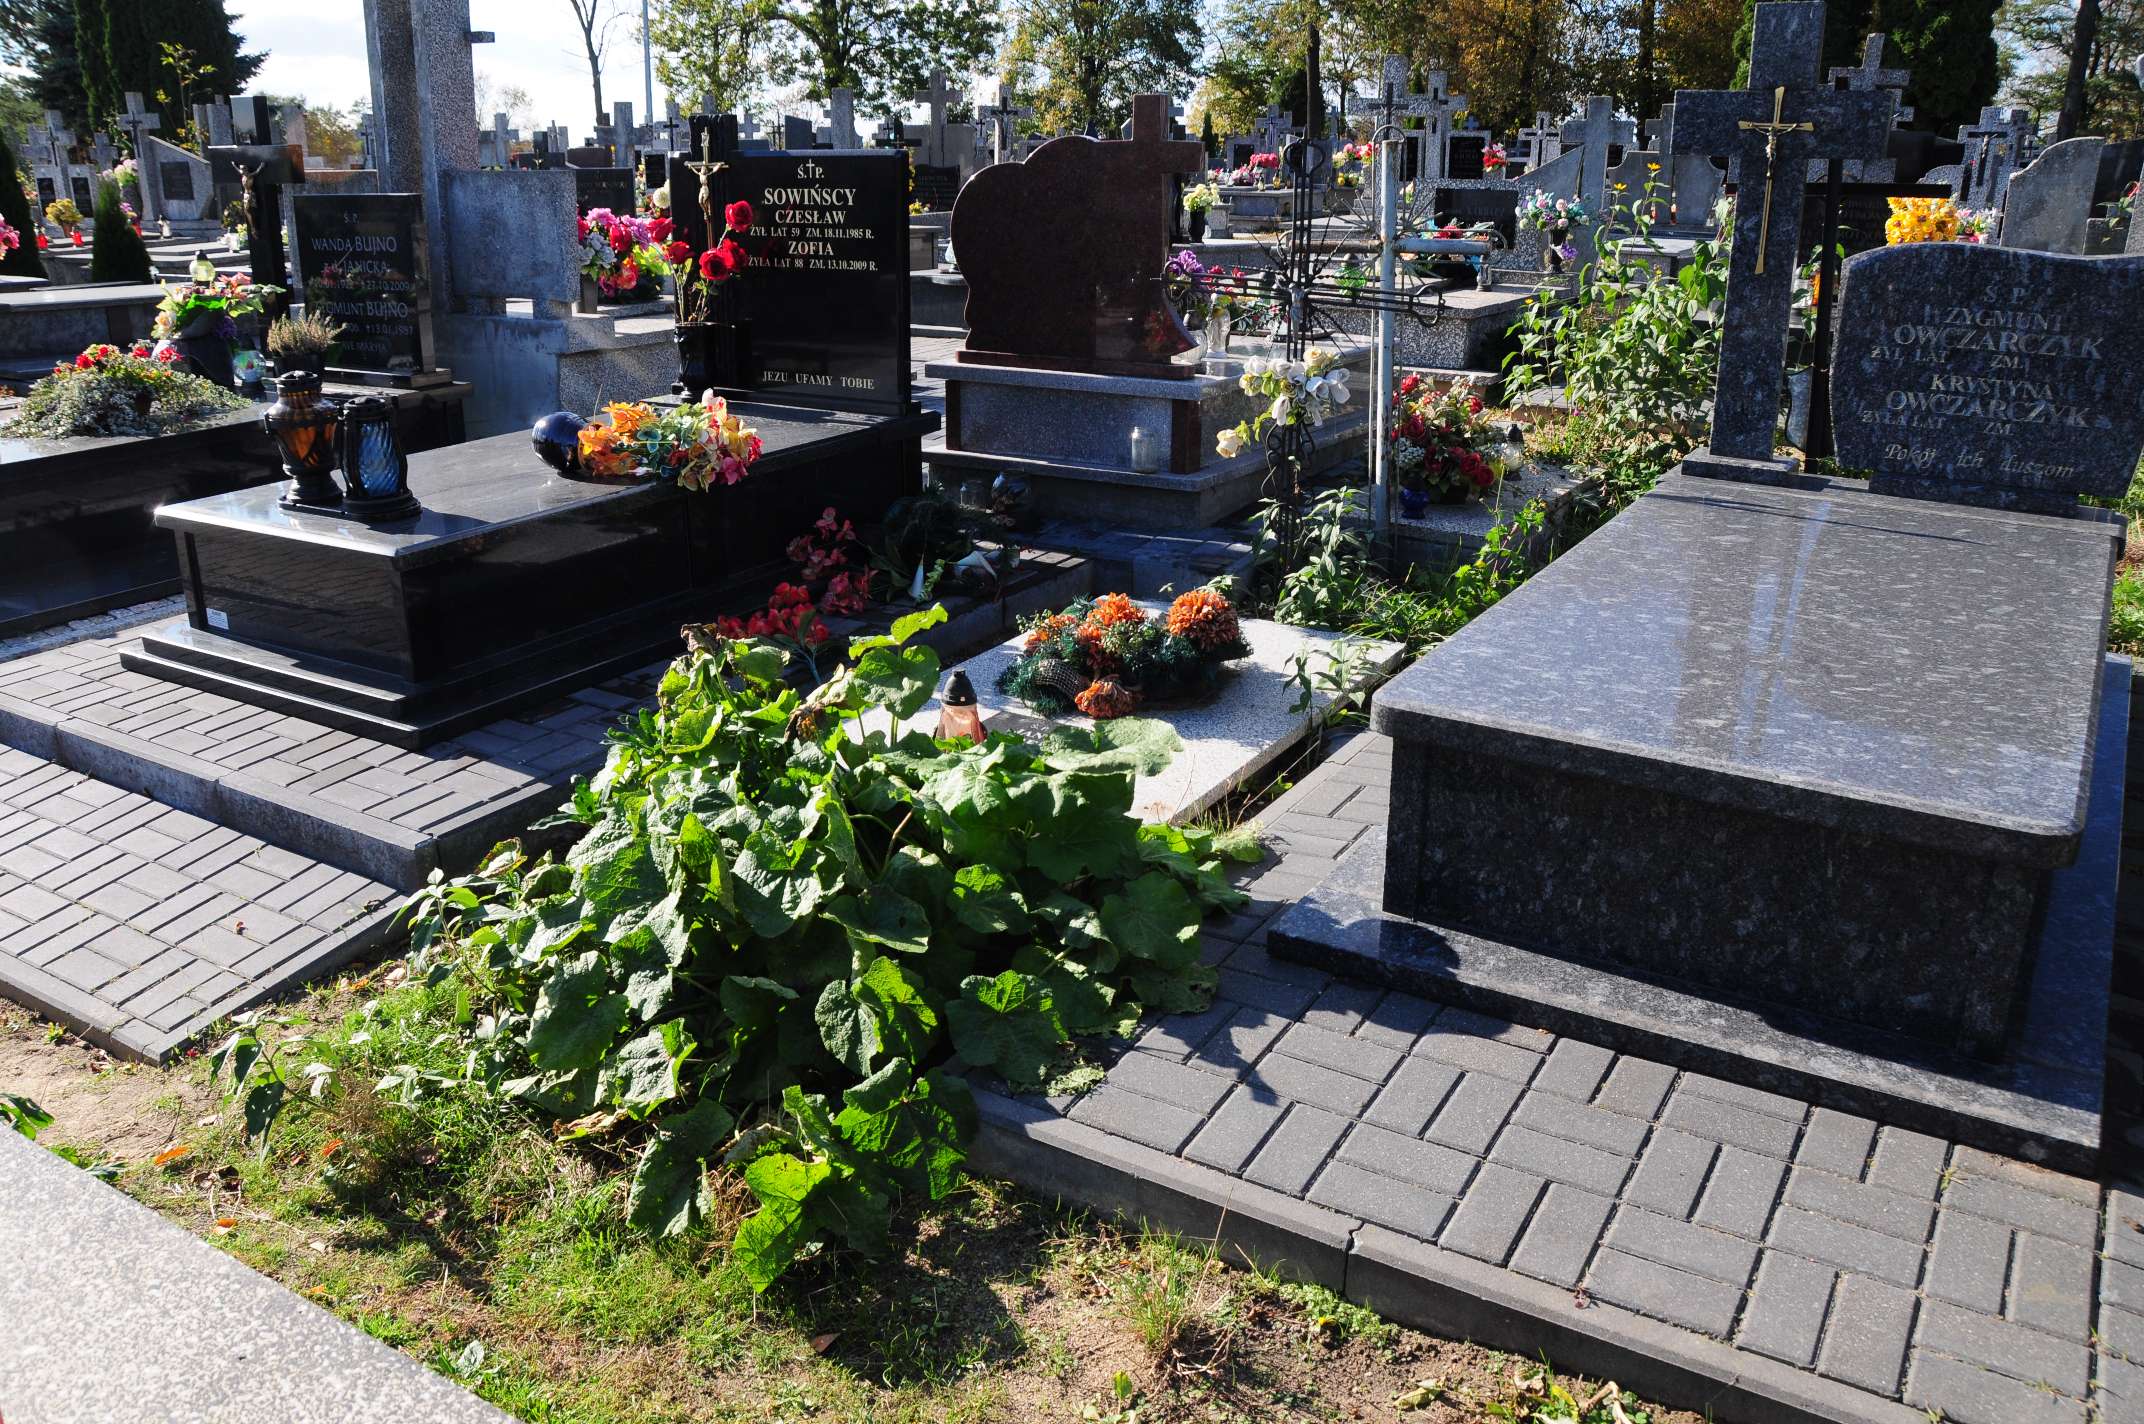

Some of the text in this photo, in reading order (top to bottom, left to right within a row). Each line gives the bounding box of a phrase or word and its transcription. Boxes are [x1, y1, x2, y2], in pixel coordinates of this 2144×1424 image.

[764, 184, 856, 206] SOWIŃSCY
[775, 209, 847, 224] CZESŁAW
[771, 227, 787, 237] LAT
[791, 227, 800, 237] 59
[806, 228, 822, 239] ZM.
[865, 229, 875, 240] R.
[311, 235, 398, 255] WANDA BUJNO
[788, 240, 834, 256] ZOFIA
[775, 258, 790, 268] LAT
[794, 258, 804, 268] 88
[809, 259, 826, 270] ZM.
[828, 260, 867, 271] 13.10.2009
[869, 261, 879, 272] R.
[366, 301, 408, 320] BUJNO
[1943, 307, 2062, 332] ZYGMUNT
[1893, 322, 2105, 360] OWCZARCZYK
[1913, 347, 1949, 364] LAT
[762, 371, 875, 390] JEZU UFAMY TOBIE
[1929, 374, 2054, 400] KRYSTYNA
[1885, 389, 2091, 429] OWCZARCZYK
[1912, 414, 1947, 430] LAT
[1884, 443, 2075, 479] Pokój ich duszom
